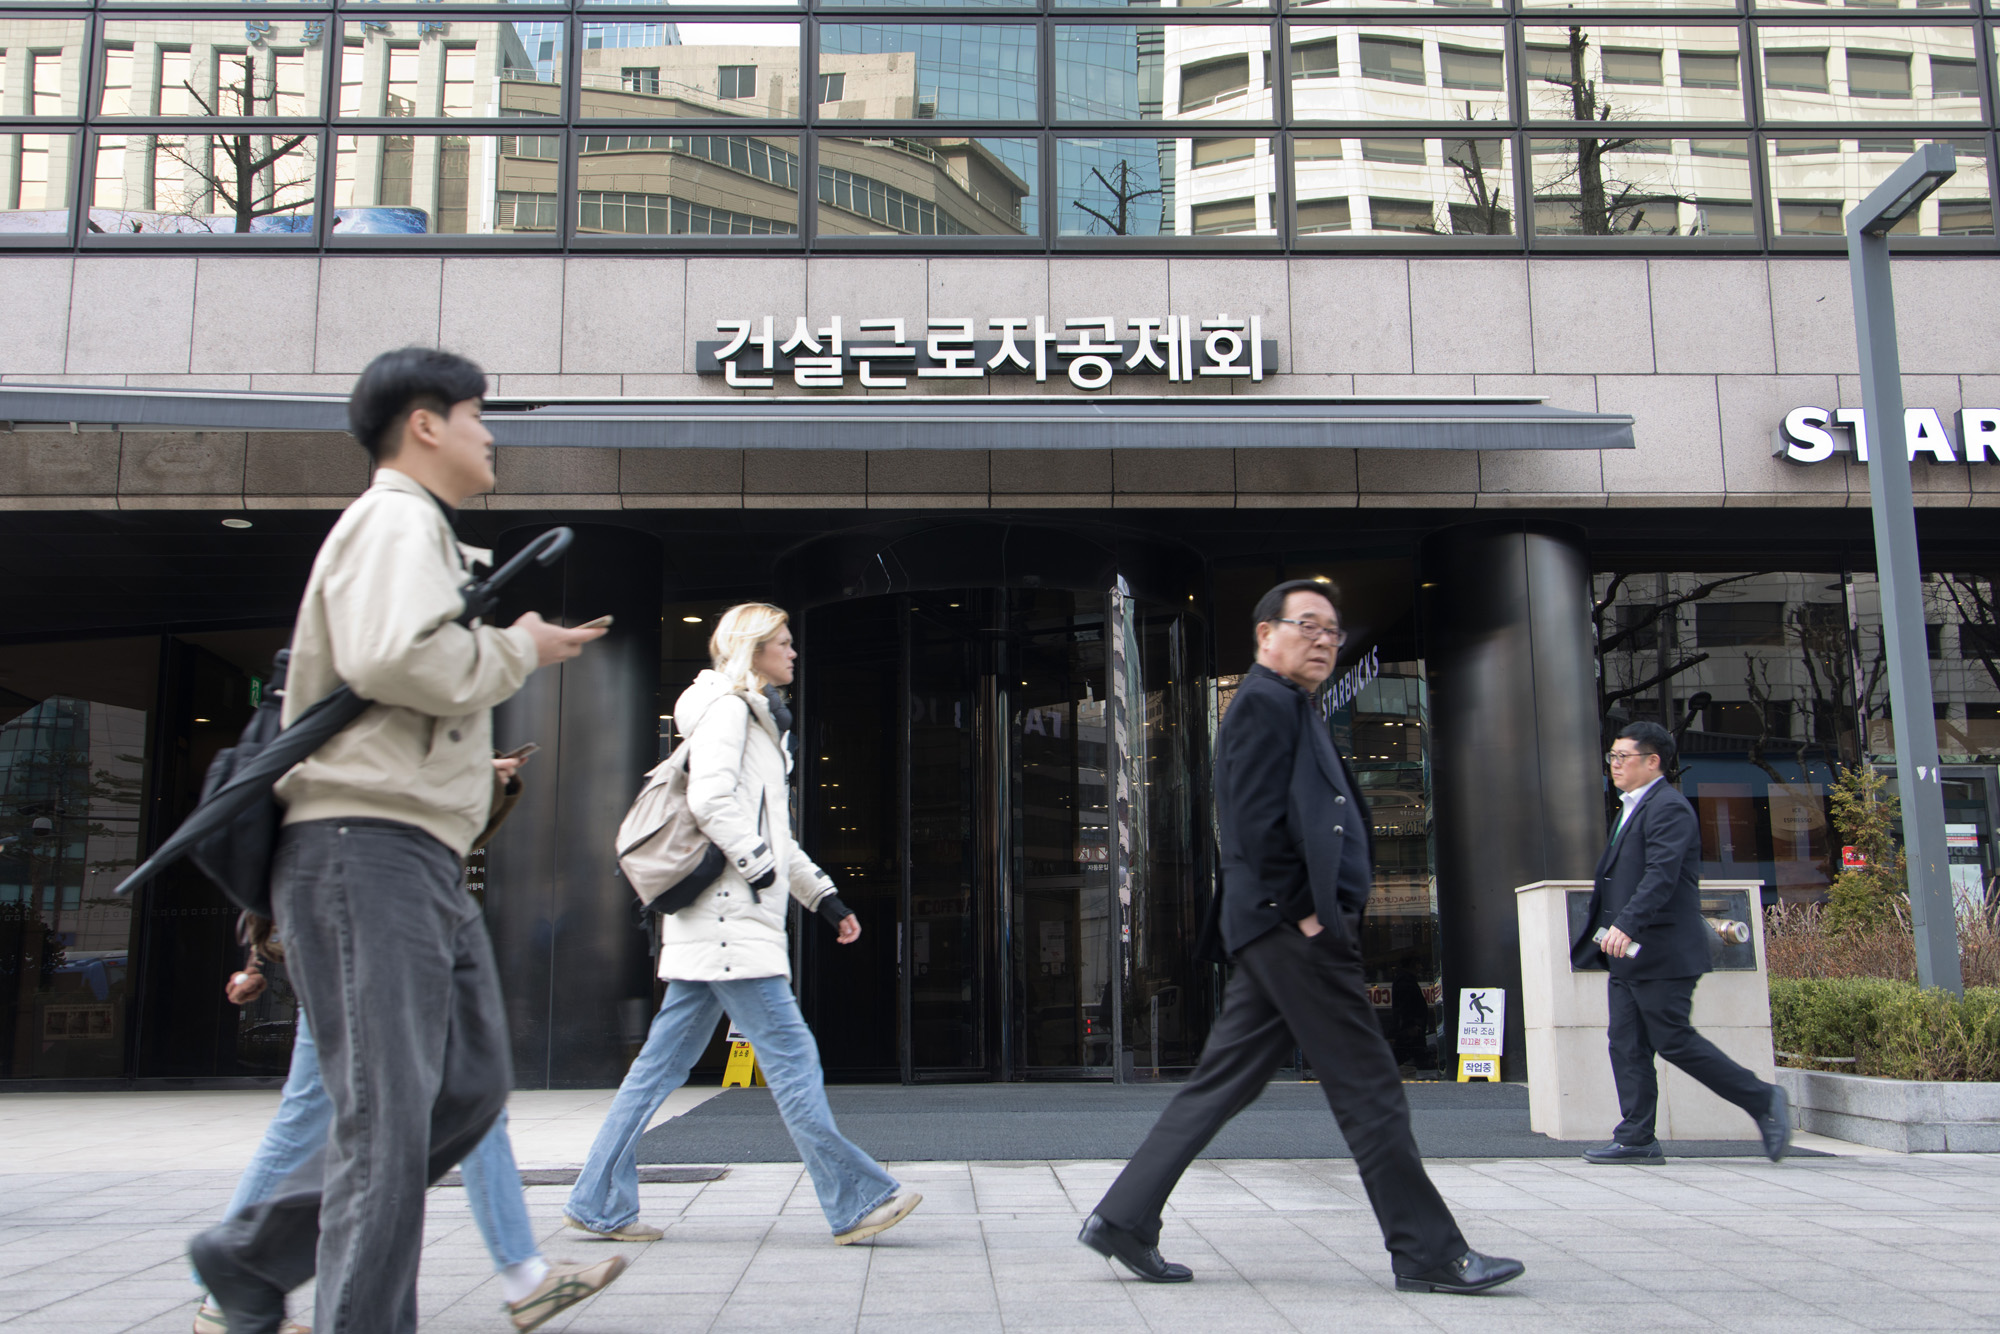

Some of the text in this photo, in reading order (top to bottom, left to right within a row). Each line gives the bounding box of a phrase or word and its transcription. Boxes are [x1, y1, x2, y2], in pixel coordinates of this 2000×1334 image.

[714, 314, 1263, 390] 건설근로자공제회
[1321, 644, 1379, 722] STARBUCKS
[1463, 1027, 1495, 1036] 바닥 조심
[1483, 1038, 1497, 1046] 주의
[1465, 1062, 1492, 1073] 작업중
